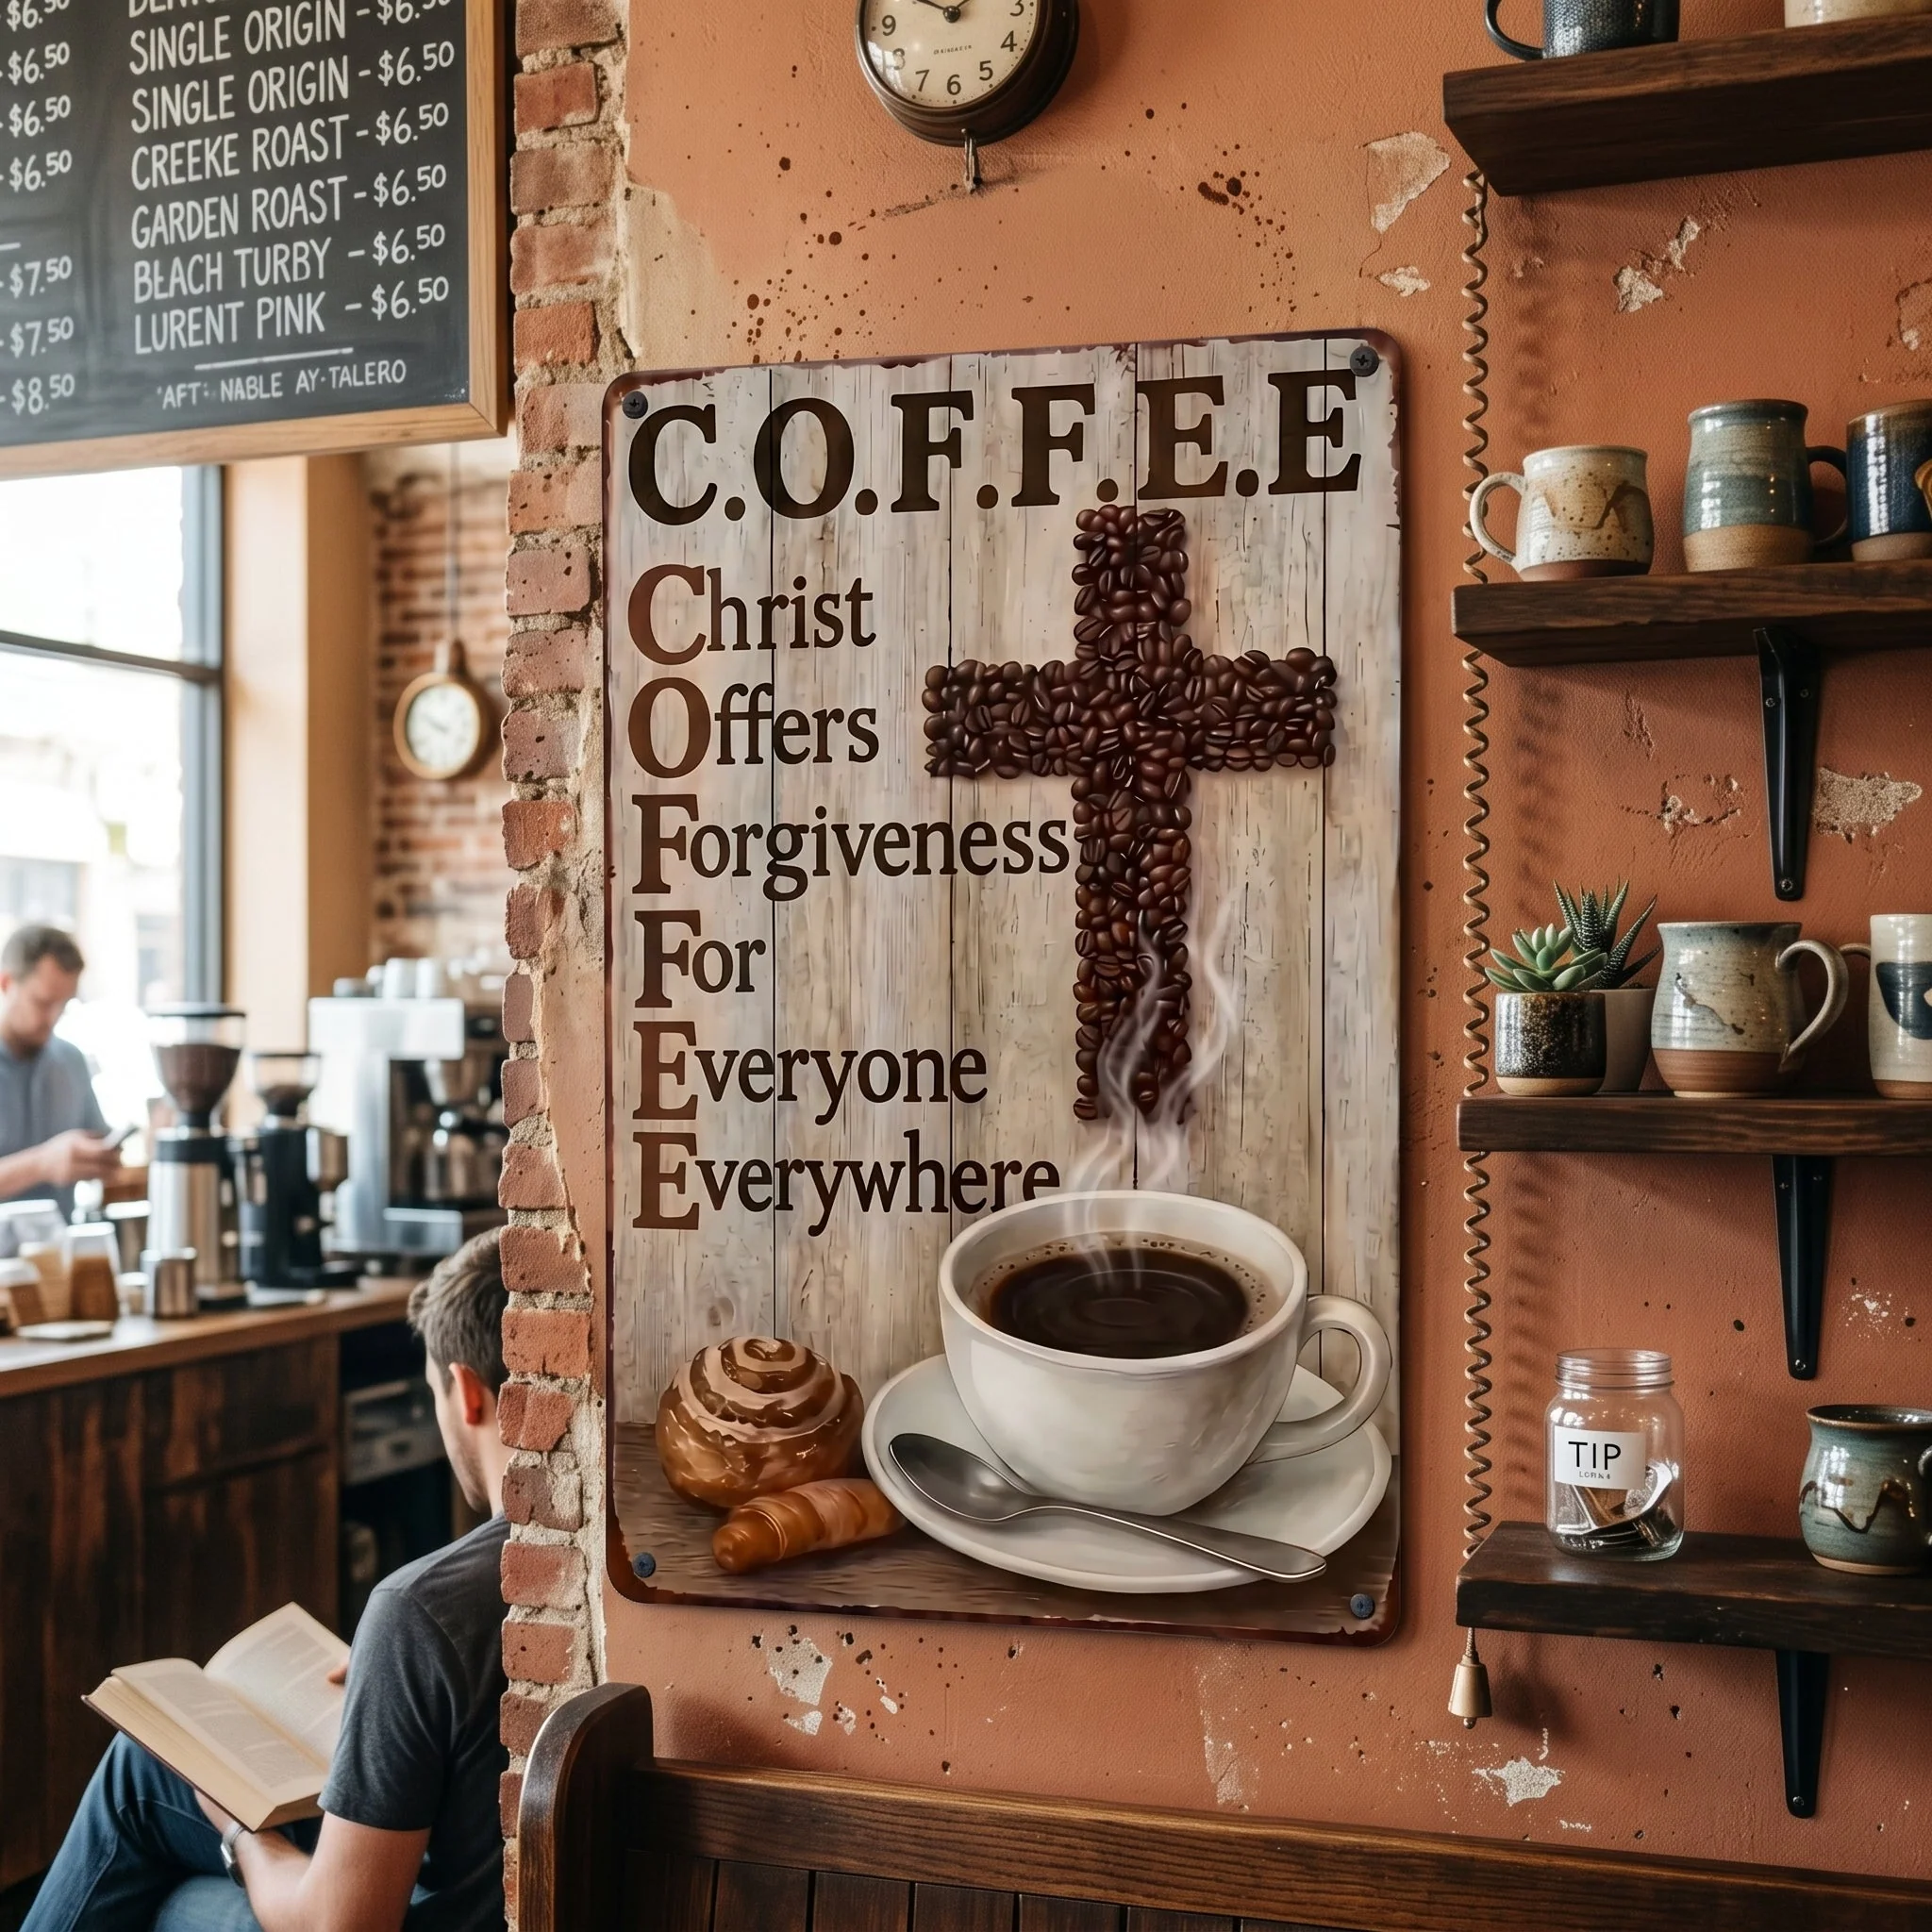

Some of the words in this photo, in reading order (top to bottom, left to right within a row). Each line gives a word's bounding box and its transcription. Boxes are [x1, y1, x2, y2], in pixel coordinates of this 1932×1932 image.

[129, 15, 232, 75] SINGLE
[243, 0, 345, 55] ORIGIN
[376, 0, 451, 25] $6.
[881, 14, 896, 37] 9
[1000, 30, 1018, 53] 4
[8, 42, 71, 86] $6.50
[130, 74, 237, 134] SINGLE
[247, 54, 349, 115] ORIGIN
[377, 40, 456, 87] $6.50
[915, 69, 930, 92] 7
[946, 74, 962, 96] 6
[979, 59, 993, 81] 5
[8, 94, 72, 139] $6.50
[8, 149, 73, 192] $6.50
[130, 132, 241, 192] CREEKE
[252, 113, 350, 173] ROAST
[375, 101, 450, 147] $6.50
[130, 192, 239, 250] GARDEN
[251, 175, 349, 234] ROAST
[373, 163, 447, 208] $6.50
[9, 255, 73, 299] $7.50
[232, 236, 332, 290] TURBY
[372, 223, 446, 267] $6.50
[9, 316, 75, 358] $7.50
[135, 301, 245, 355] LURENT
[257, 291, 326, 341] PINK
[371, 275, 450, 322] $6.50
[11, 373, 75, 416] $8.50
[220, 372, 284, 403] NABLE
[628, 369, 1362, 526] C.O.F.F.E.E
[627, 563, 877, 666] Christ
[627, 676, 879, 780] Offers
[631, 793, 1071, 902] Forgiveness
[634, 909, 767, 1008] For
[632, 1021, 989, 1126] Everyone
[632, 1128, 1061, 1238] Everywhere
[1568, 1441, 1622, 1471] TIP
